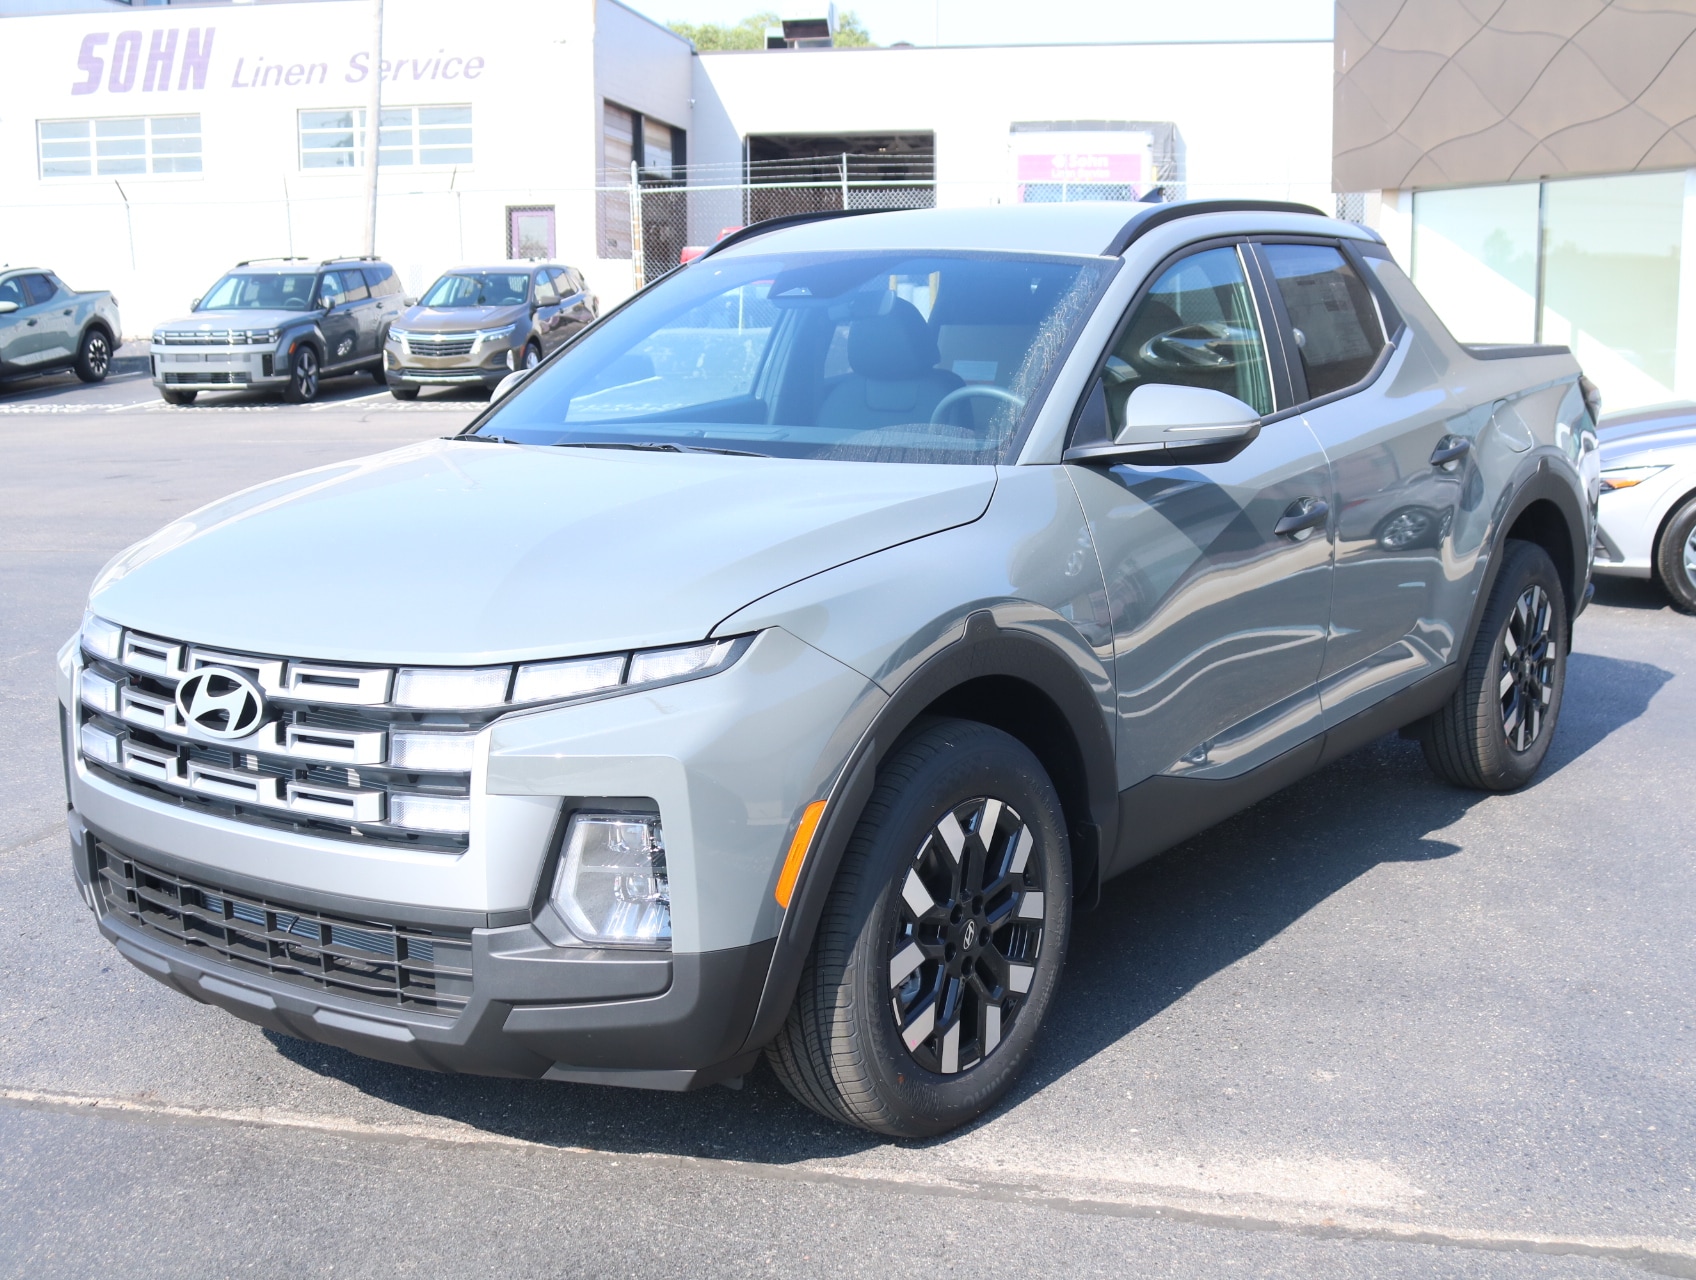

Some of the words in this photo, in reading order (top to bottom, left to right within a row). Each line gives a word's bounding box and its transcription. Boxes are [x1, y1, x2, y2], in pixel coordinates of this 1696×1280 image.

[71, 27, 216, 95] SOHN
[231, 56, 328, 88] Linen
[344, 48, 485, 84] Service
